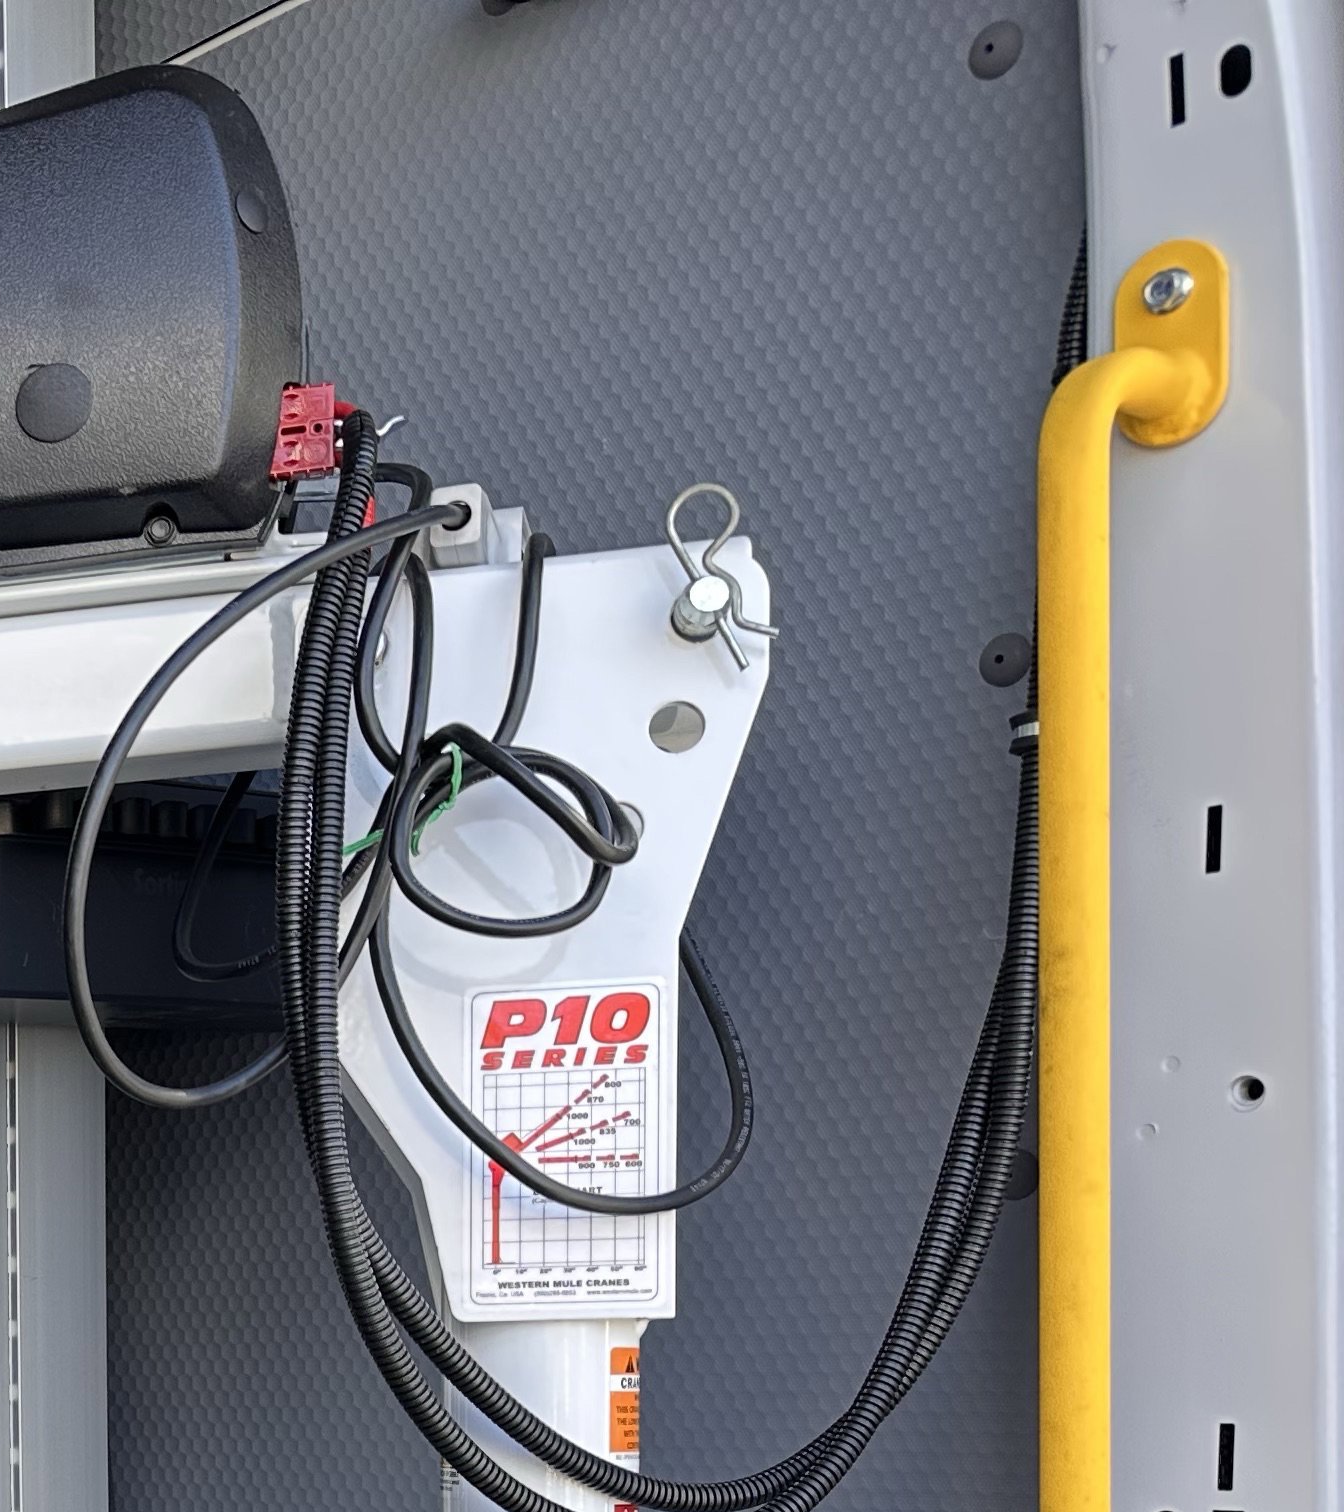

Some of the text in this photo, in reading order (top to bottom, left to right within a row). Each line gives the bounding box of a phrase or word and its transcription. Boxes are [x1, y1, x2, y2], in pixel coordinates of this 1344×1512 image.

[480, 992, 651, 1049] P10
[480, 1045, 649, 1071] SERIES
[624, 1118, 641, 1126] 700
[573, 1138, 596, 1146] 1000
[498, 1278, 630, 1290] WESTERN MULE CRANES
